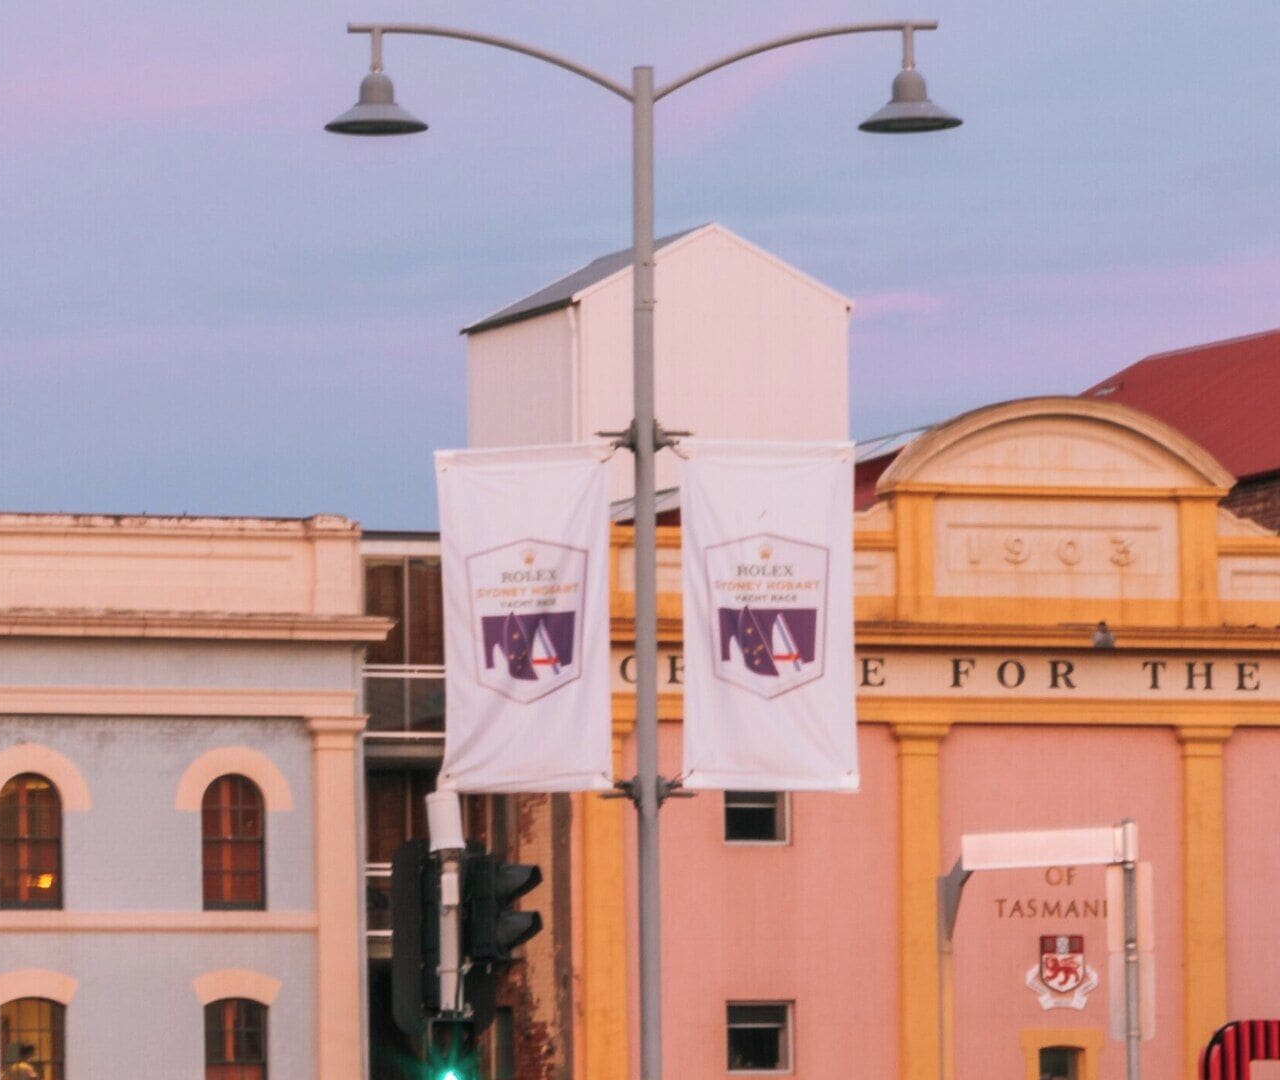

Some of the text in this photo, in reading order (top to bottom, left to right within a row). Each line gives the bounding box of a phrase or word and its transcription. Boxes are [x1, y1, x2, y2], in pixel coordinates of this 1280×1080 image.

[500, 569, 558, 583] ROLEX
[736, 564, 795, 577] ROLEX
[949, 657, 1077, 690] FOR
[1142, 661, 1262, 692] THE
[1044, 866, 1077, 886] OF
[995, 899, 1108, 919] TASMANI
